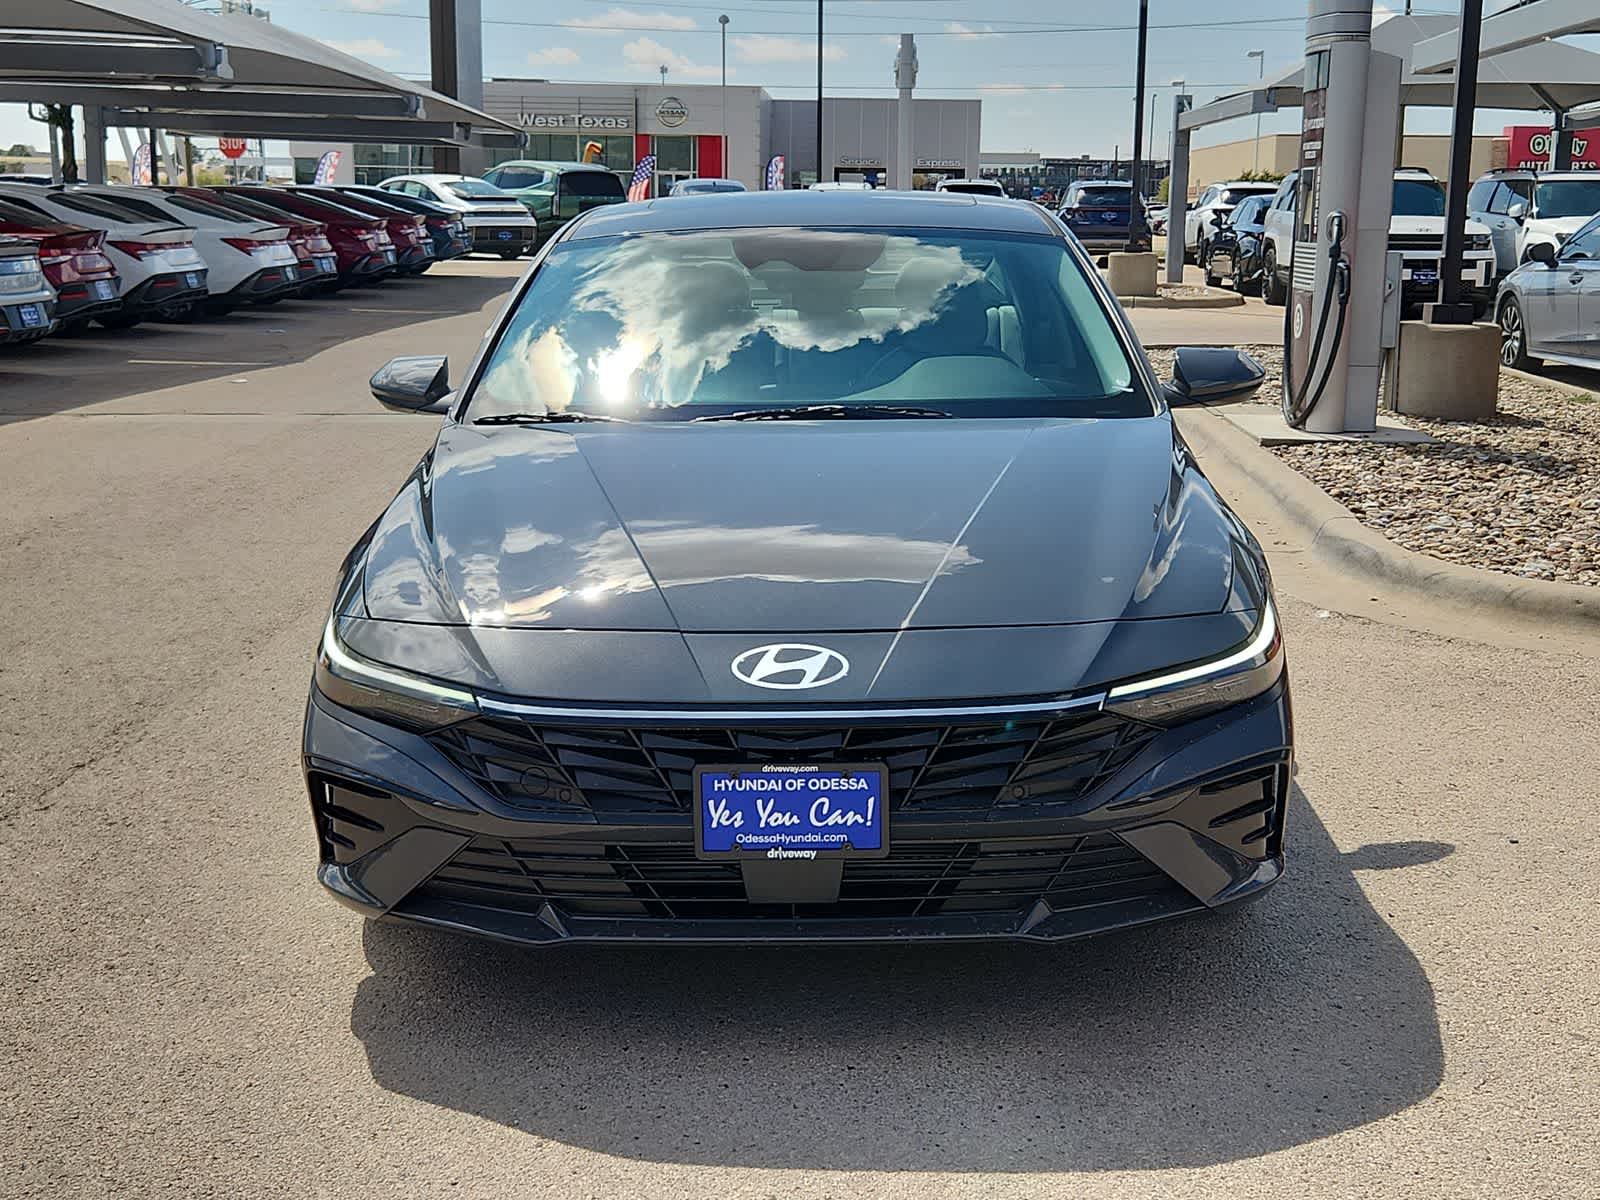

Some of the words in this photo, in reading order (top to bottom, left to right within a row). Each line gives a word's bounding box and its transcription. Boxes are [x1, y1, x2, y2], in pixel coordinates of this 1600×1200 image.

[518, 113, 565, 127] West
[570, 114, 629, 128] Texas
[220, 138, 246, 150] STOP
[916, 158, 961, 168] Express
[762, 764, 819, 774] driveway.com
[714, 779, 783, 792] HYUNDAI
[785, 779, 806, 791] OF
[808, 778, 869, 791] ODESSA
[707, 798, 744, 829] Yes
[756, 798, 800, 828] You
[809, 796, 875, 828] Can!
[736, 832, 848, 845] OdessaHyundai.com
[767, 847, 817, 860] driveway
